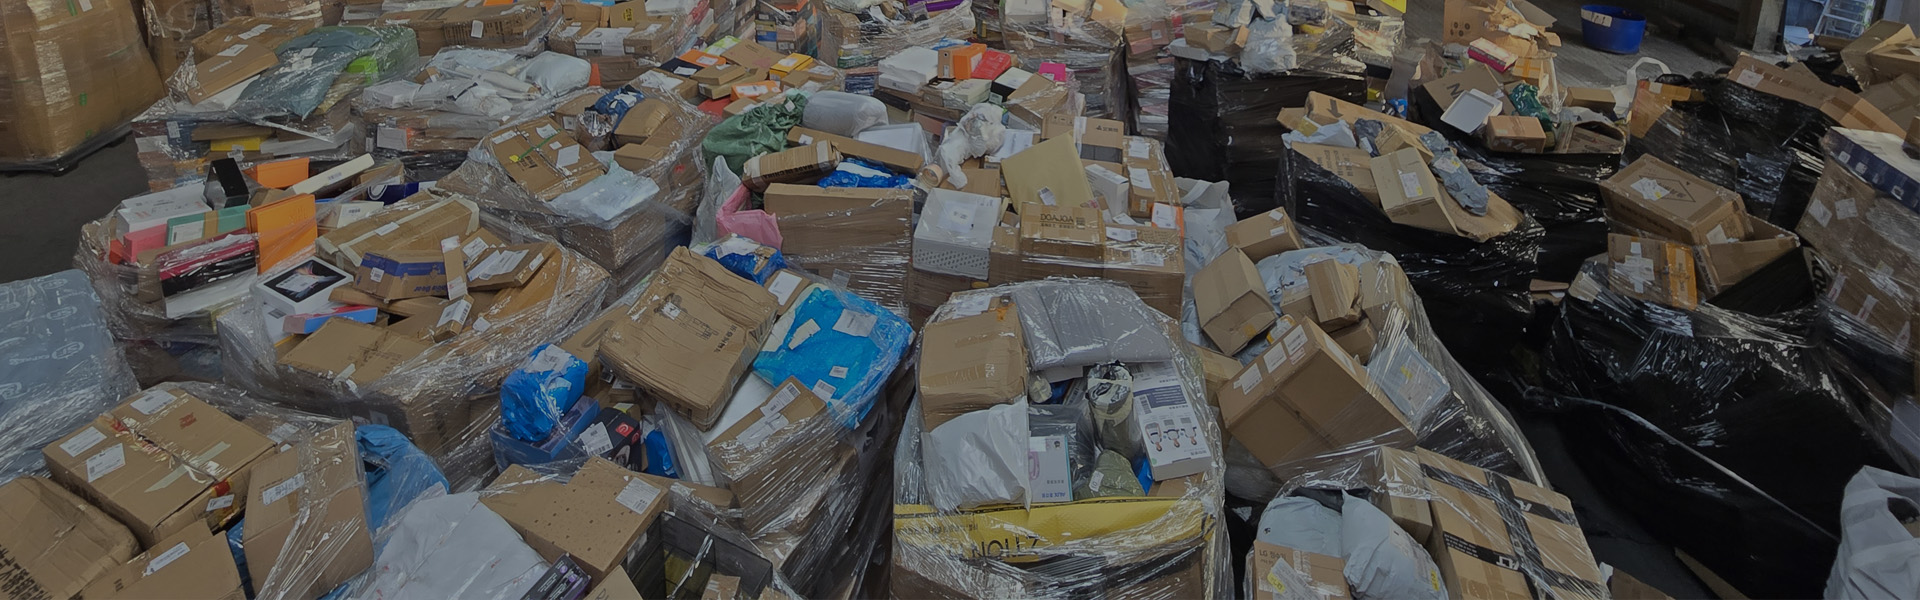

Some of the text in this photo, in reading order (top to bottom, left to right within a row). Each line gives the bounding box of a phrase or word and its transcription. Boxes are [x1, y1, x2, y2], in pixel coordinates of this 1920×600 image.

[794, 164, 813, 172] MADE
[762, 170, 785, 179] CHINA
[1259, 549, 1268, 557] LG
